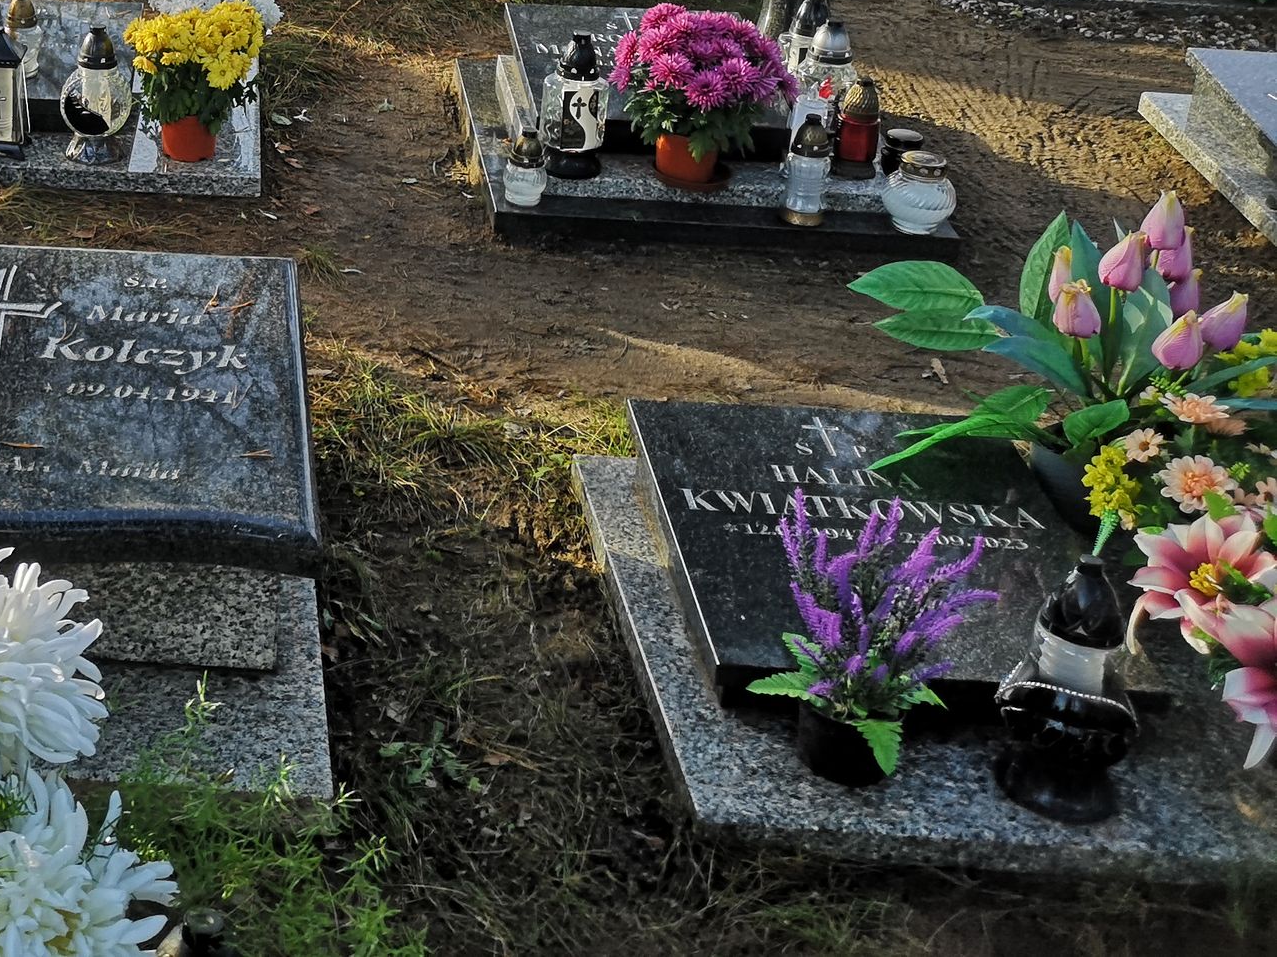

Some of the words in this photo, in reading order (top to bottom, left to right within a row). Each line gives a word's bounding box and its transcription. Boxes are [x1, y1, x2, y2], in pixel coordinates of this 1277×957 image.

[87, 304, 203, 326] Maria
[39, 335, 248, 375] Kolczyk
[770, 464, 923, 491] HALINA
